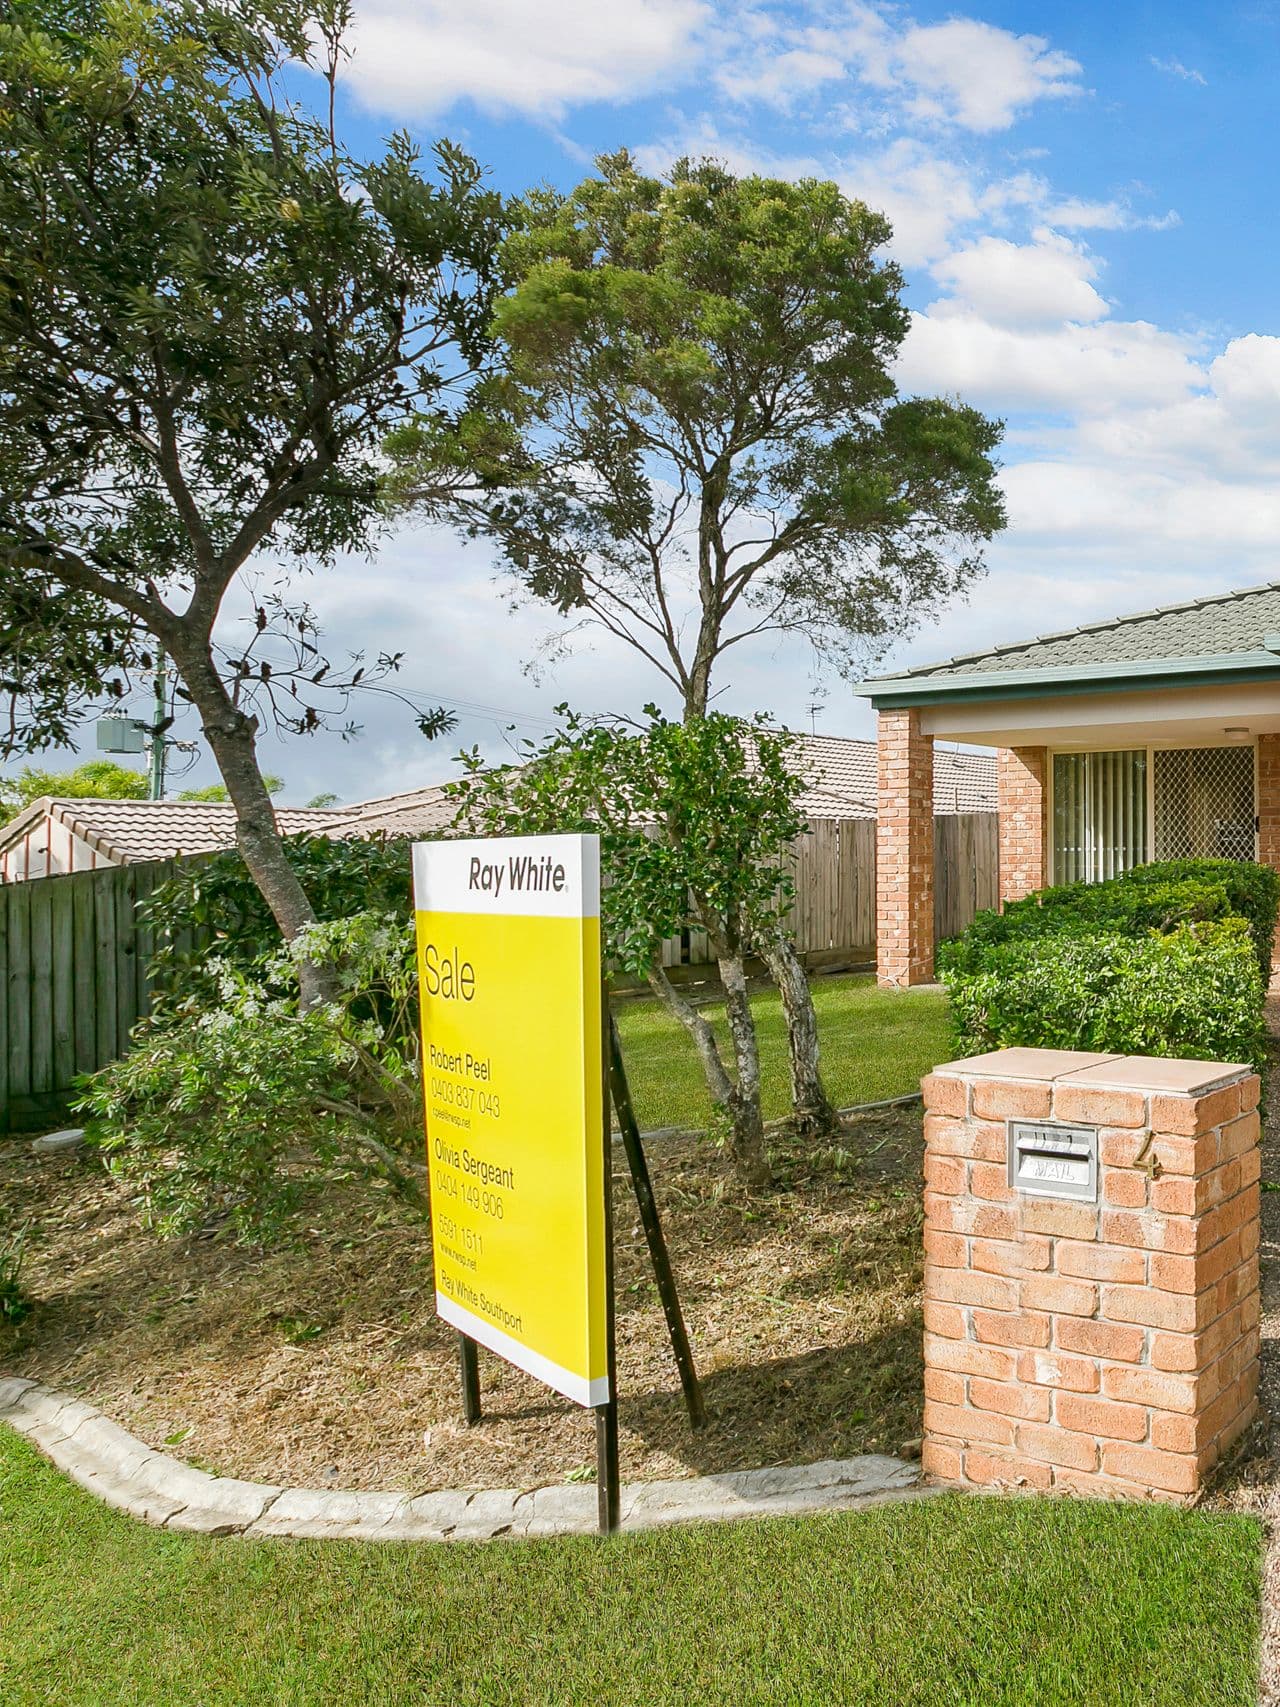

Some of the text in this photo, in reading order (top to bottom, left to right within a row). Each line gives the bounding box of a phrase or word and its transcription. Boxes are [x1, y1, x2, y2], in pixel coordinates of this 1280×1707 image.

[469, 856, 565, 897] Ray White
[425, 945, 475, 1001] Sale
[430, 1044, 490, 1081] Robert Peel
[432, 1077, 500, 1118] 0403 837 043
[435, 1138, 514, 1190] Olivia Sergeant
[1034, 1161, 1075, 1181] MAIL
[1133, 1131, 1161, 1180] 4
[436, 1170, 504, 1220] 0404 149 906
[439, 1213, 483, 1255] 5591 1511
[441, 1270, 523, 1333] Ray White Southport
